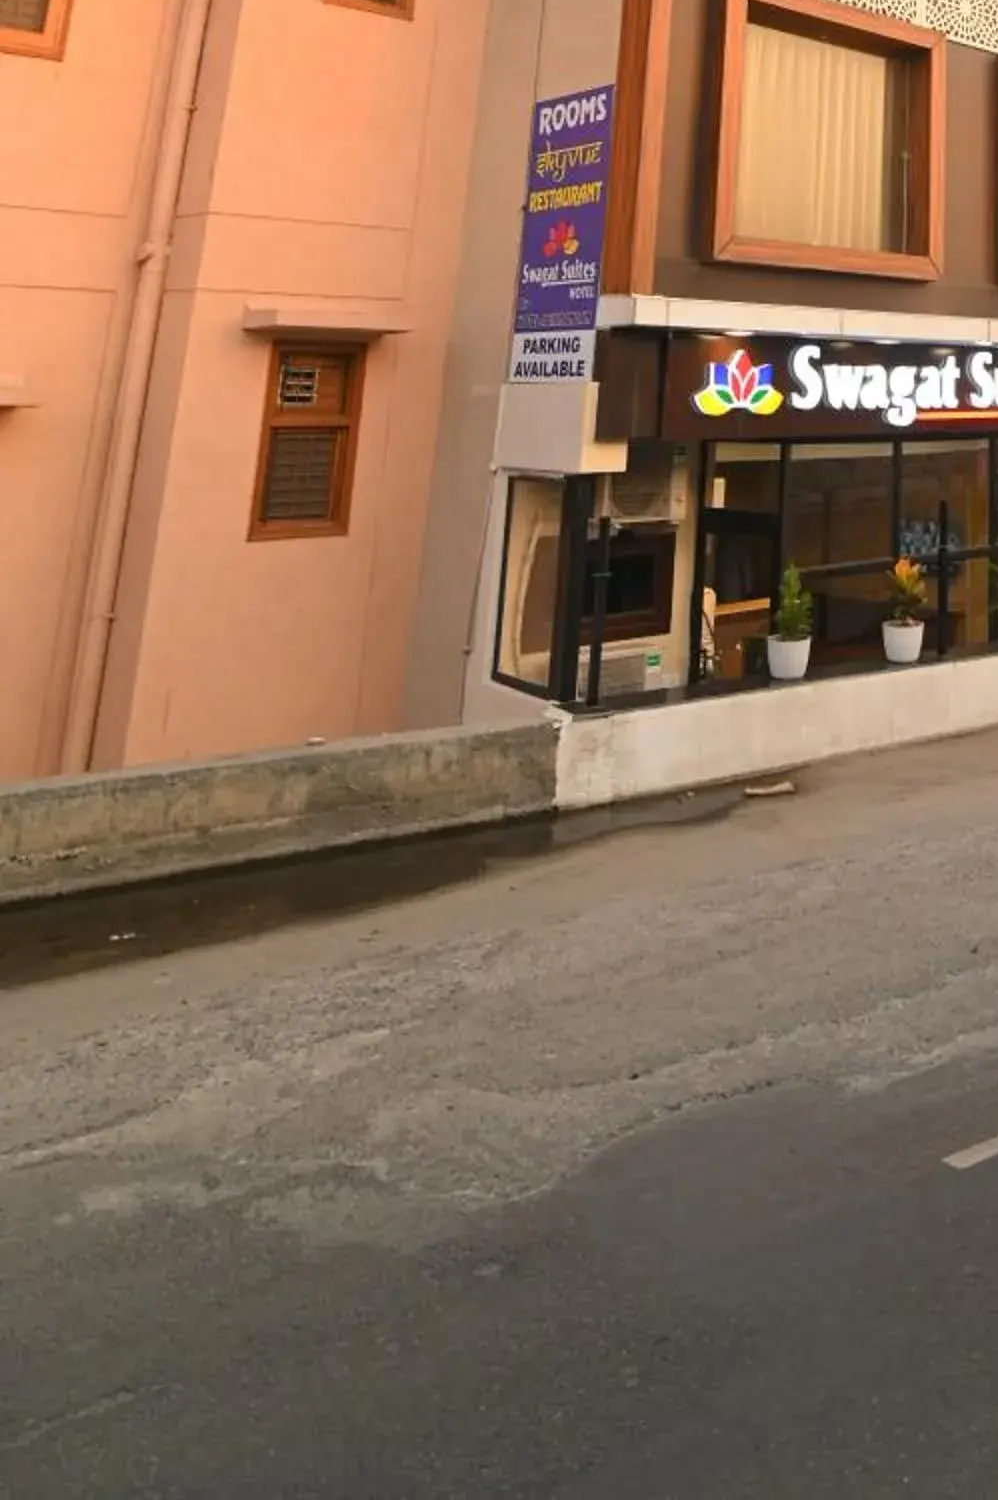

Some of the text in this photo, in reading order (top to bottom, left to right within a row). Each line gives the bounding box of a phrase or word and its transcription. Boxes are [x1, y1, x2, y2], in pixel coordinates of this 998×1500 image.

[539, 92, 607, 136] ROOMS
[529, 181, 603, 212] RESTAURANT
[561, 257, 597, 282] Suites
[522, 335, 581, 355] PARKING
[513, 359, 585, 379] AVAILABLE
[790, 344, 960, 427] Swagat
